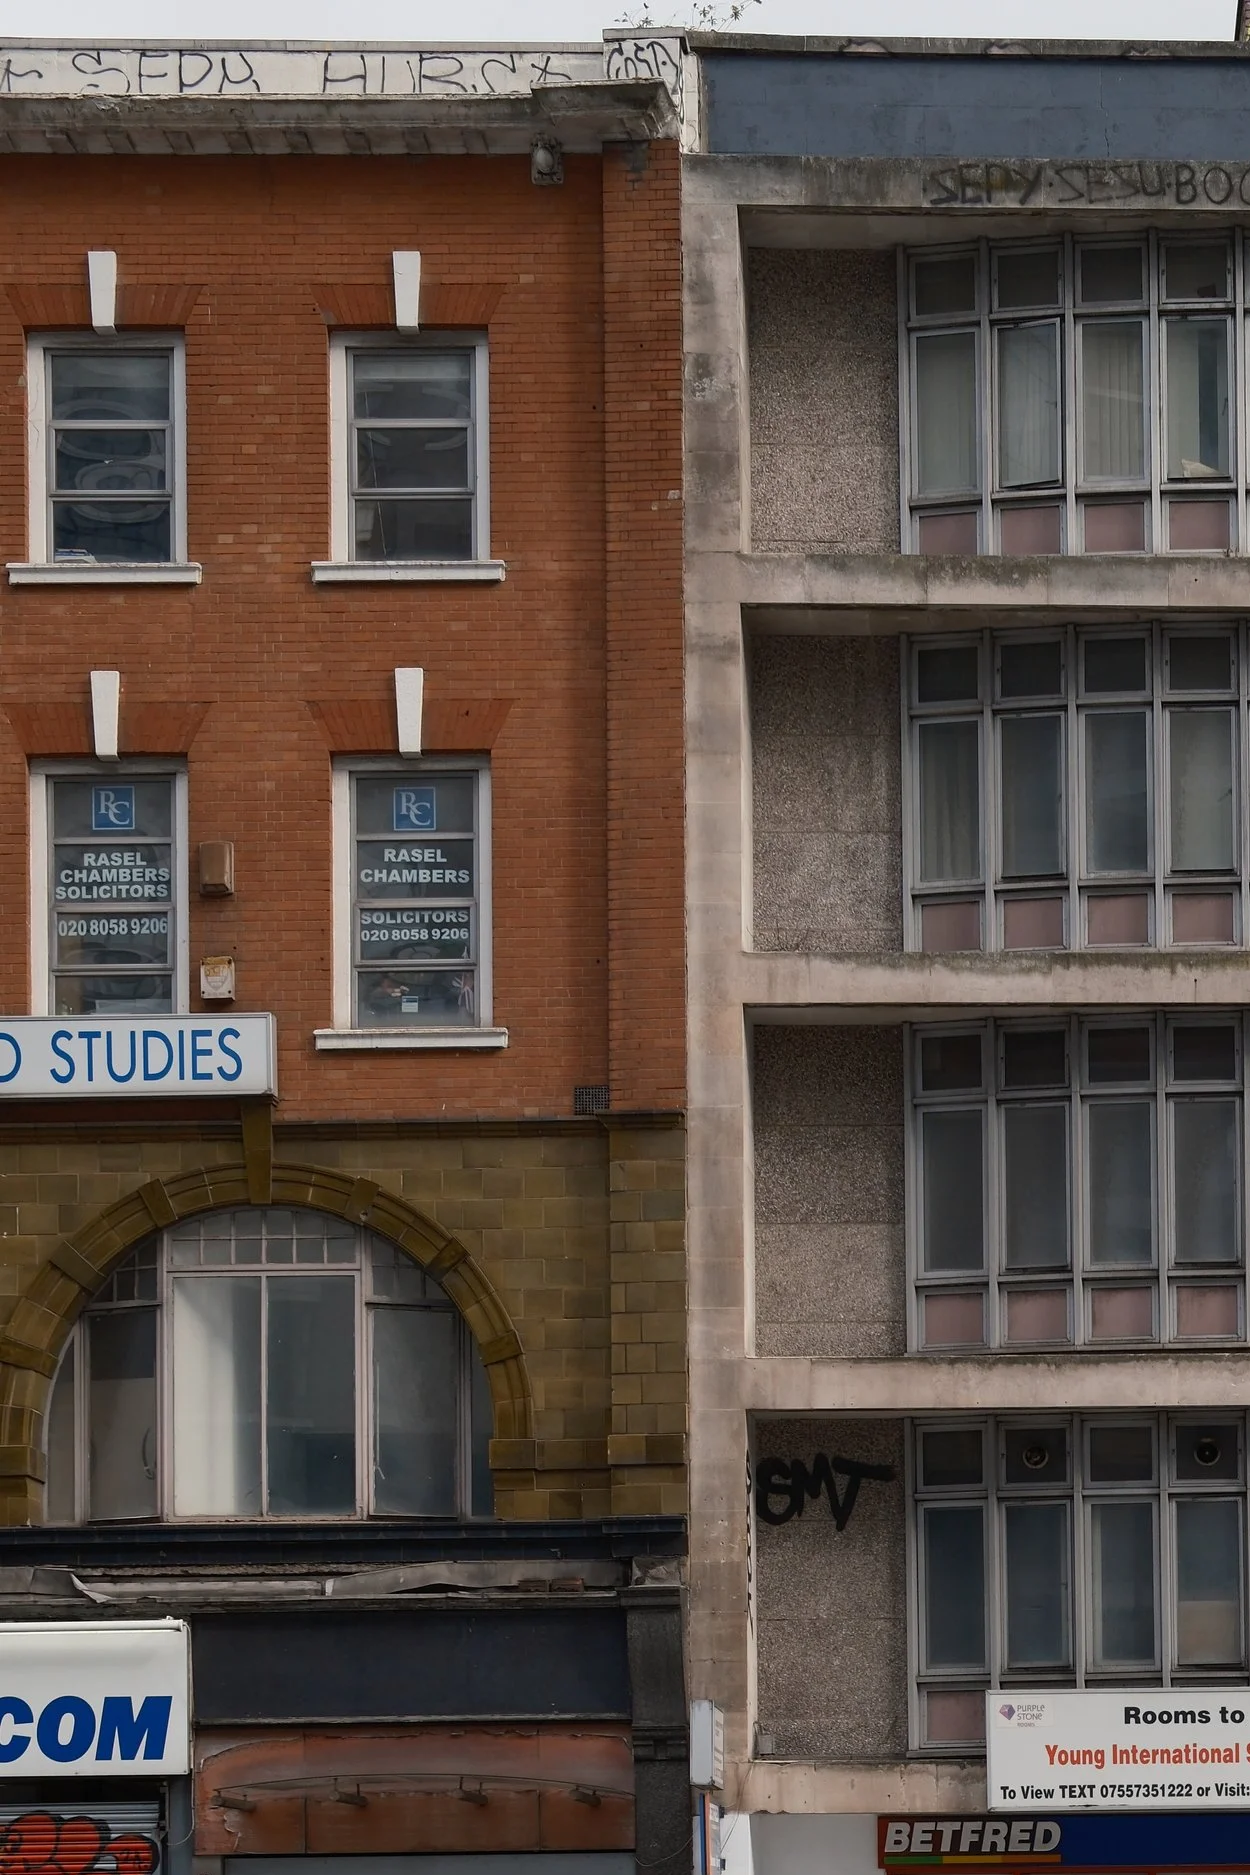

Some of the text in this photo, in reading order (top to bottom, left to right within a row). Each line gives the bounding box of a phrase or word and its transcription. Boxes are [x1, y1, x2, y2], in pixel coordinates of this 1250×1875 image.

[83, 852, 147, 867] RASEL
[384, 848, 447, 863] RASEL
[60, 868, 170, 883] CHAMBERS
[360, 869, 470, 884] CHAMBERS
[55, 884, 168, 900] SOLICITORS
[360, 910, 469, 925] SOLICITORS
[58, 917, 168, 937] 020 8058 9206
[361, 928, 469, 941] 020 8058 9206
[50, 1027, 243, 1083] STUDIES
[1017, 1704, 1045, 1713] PURPLE
[1124, 1706, 1211, 1725] Rooms
[1219, 1706, 1245, 1724] to
[0, 1695, 173, 1763] COM
[1045, 1744, 1105, 1769] Young
[1112, 1743, 1240, 1765] International
[1000, 1785, 1016, 1799] To
[1021, 1785, 1054, 1799] View
[1059, 1785, 1096, 1798] TEXT
[1100, 1784, 1193, 1798] 07557351222
[1197, 1786, 1211, 1797] or
[1215, 1783, 1250, 1797] Visit:
[883, 1821, 1061, 1852] BETFRED
